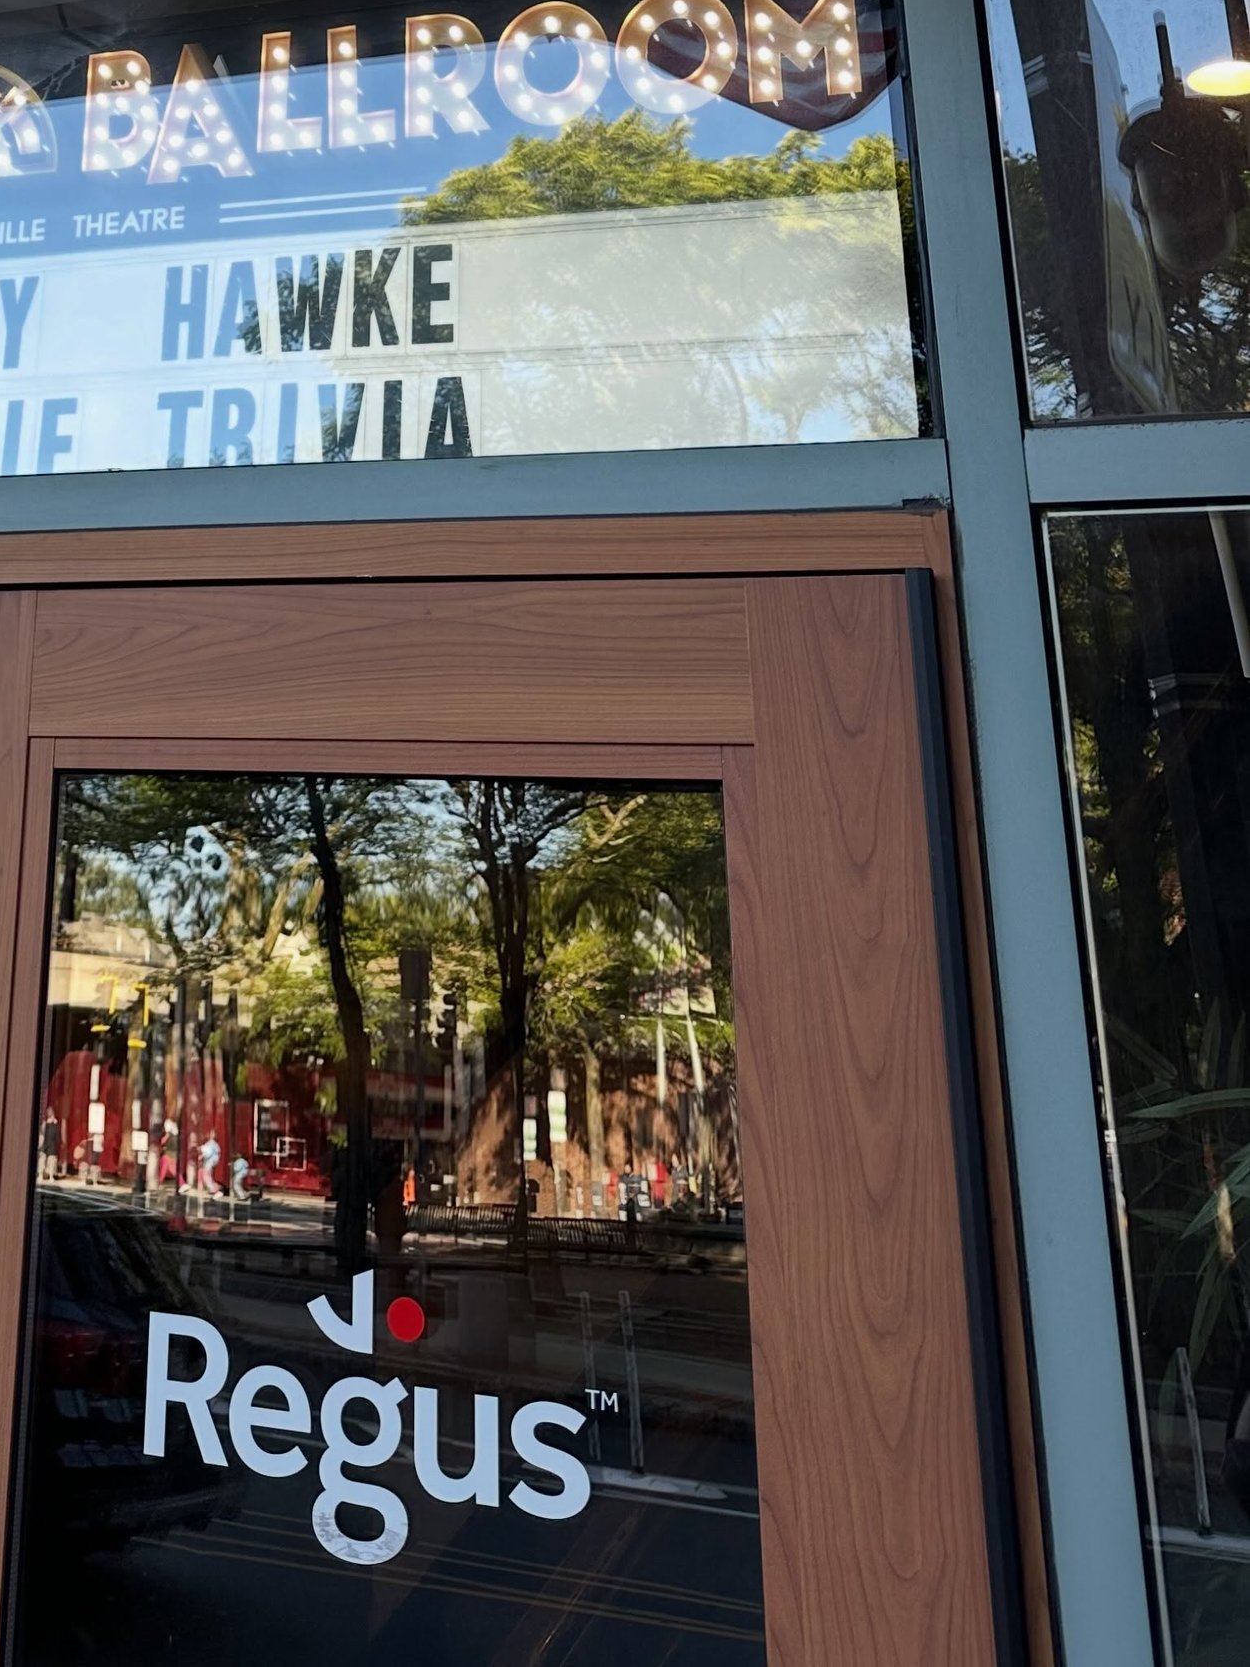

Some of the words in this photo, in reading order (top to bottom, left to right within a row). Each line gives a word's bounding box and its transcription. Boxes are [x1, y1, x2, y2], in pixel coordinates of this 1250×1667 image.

[73, 205, 185, 239] THEATRE
[161, 243, 454, 361] HAWKE
[157, 376, 473, 468] TRIVIA
[143, 1311, 591, 1565] Regus
